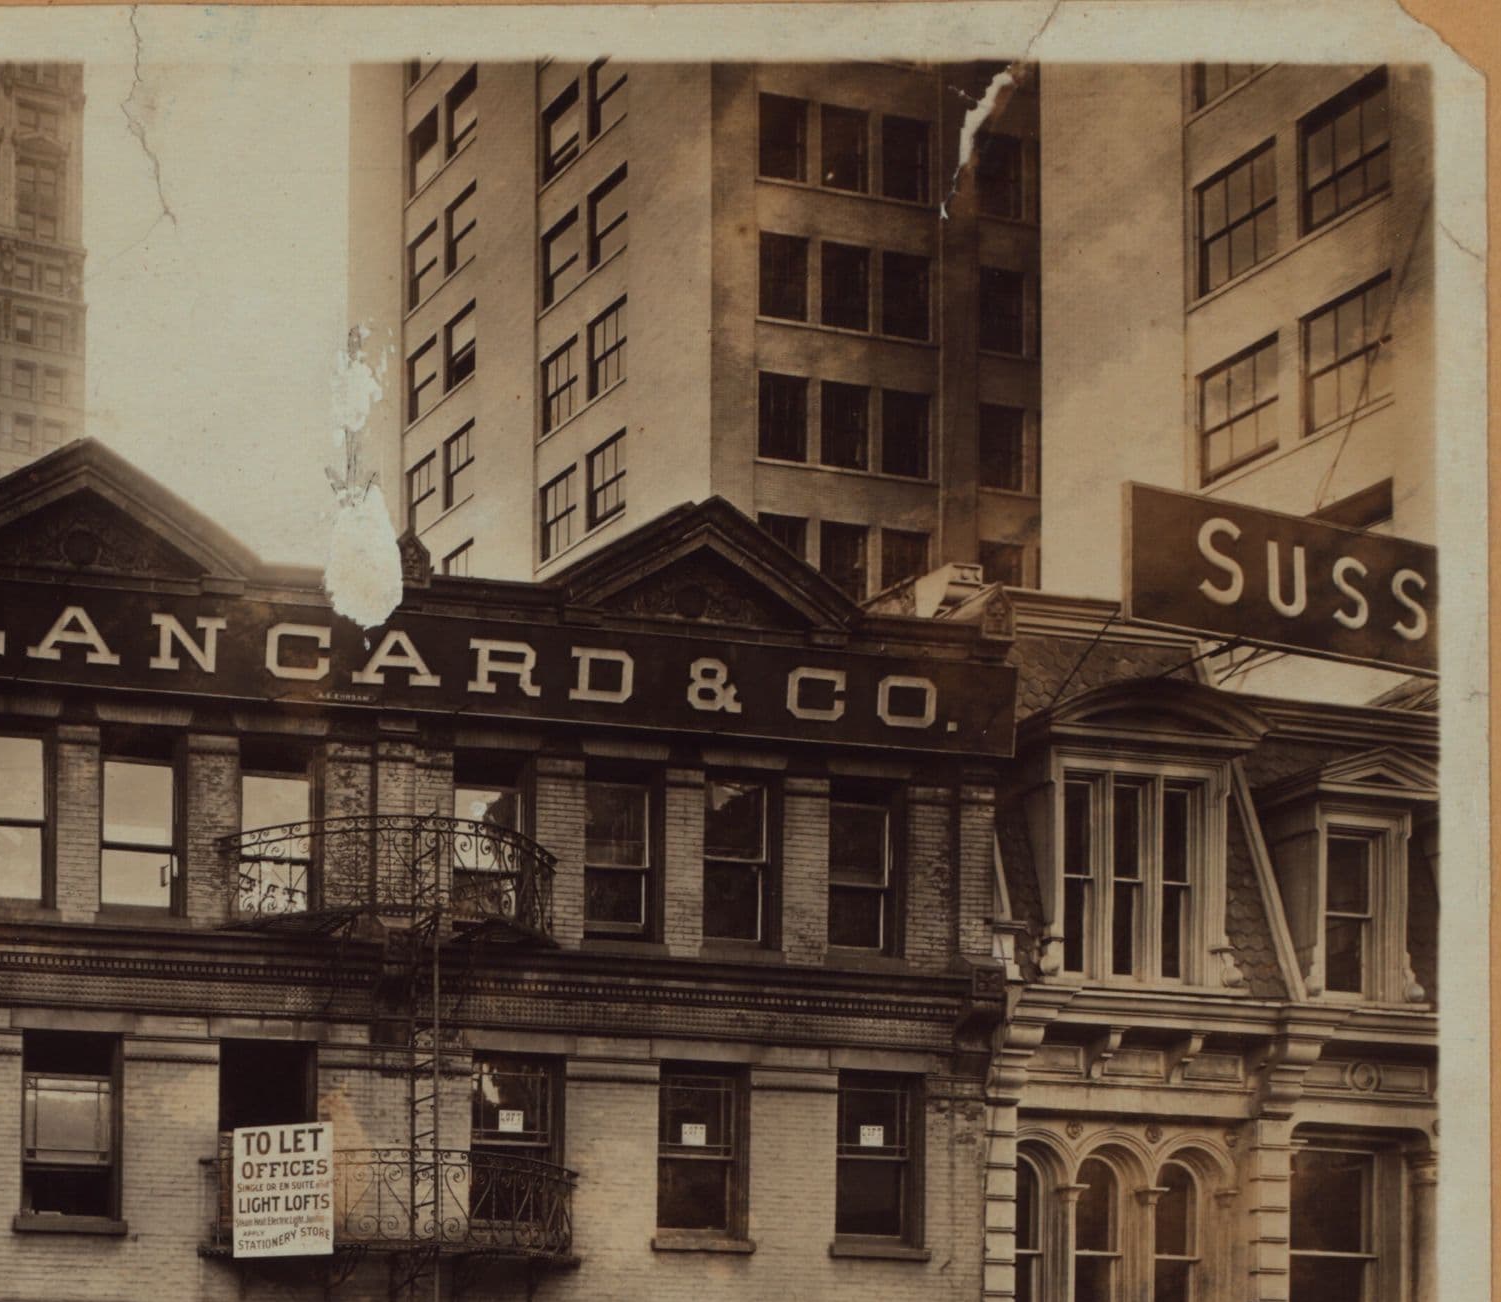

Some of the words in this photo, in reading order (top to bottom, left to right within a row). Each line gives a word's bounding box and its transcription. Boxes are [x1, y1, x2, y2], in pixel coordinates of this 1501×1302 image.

[1197, 516, 1430, 642] SUSS
[686, 656, 743, 714] &
[785, 665, 958, 733] CO.
[241, 1131, 271, 1156] TO
[279, 1127, 324, 1154] LET
[241, 1159, 328, 1179] OFFICES
[266, 1182, 276, 1191] OR
[279, 1181, 289, 1191] EN
[291, 1180, 315, 1190] SUITE
[238, 1195, 281, 1214] LIGHT
[284, 1193, 330, 1211] LOFTS
[238, 1229, 297, 1250] STATIONERY
[300, 1226, 330, 1241] STORE
